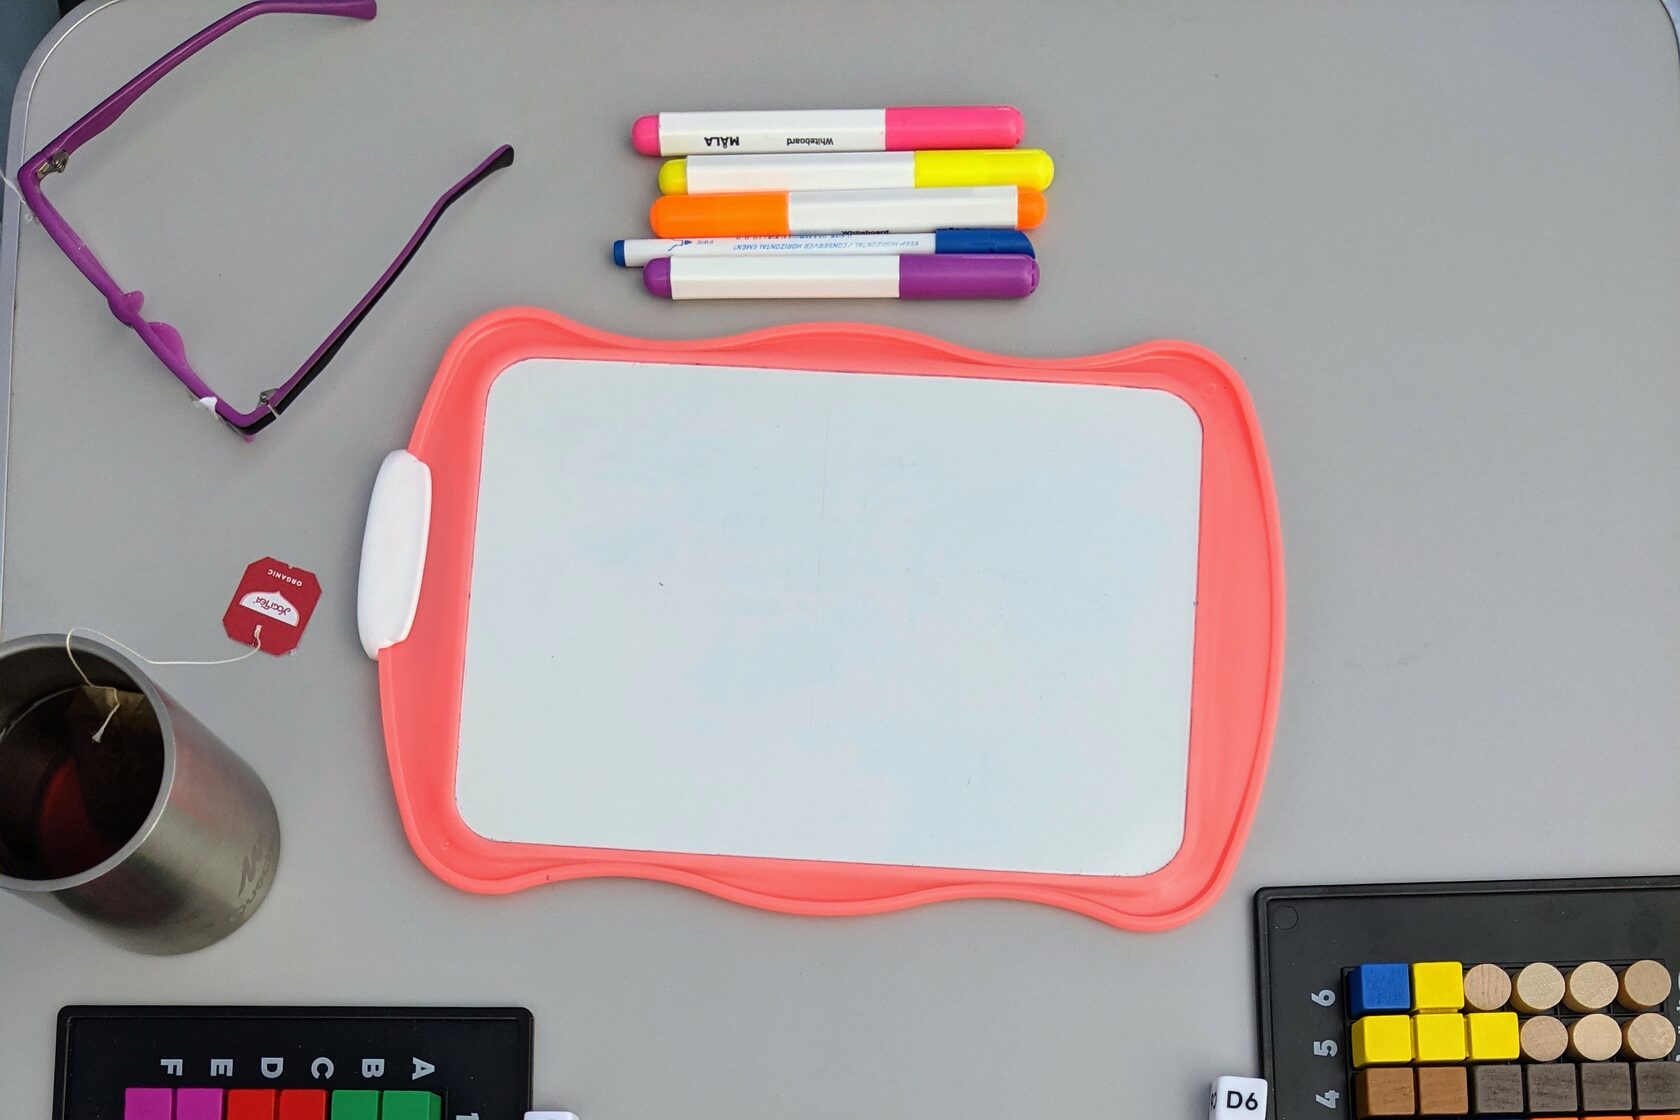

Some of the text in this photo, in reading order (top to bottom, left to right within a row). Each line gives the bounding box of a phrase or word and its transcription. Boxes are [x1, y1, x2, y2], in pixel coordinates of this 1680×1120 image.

[704, 137, 834, 148] MÅLA Whiteboard
[267, 568, 303, 587] ORGANIC
[1311, 990, 1335, 1006] 6
[1314, 1040, 1337, 1057] 5
[161, 1059, 183, 1075] F
[211, 1059, 233, 1076] E
[261, 1058, 283, 1078] D
[311, 1057, 334, 1079] C
[362, 1059, 384, 1078] B
[412, 1057, 435, 1080] A
[1227, 1091, 1258, 1110] D6
[1316, 1091, 1339, 1108] 4
